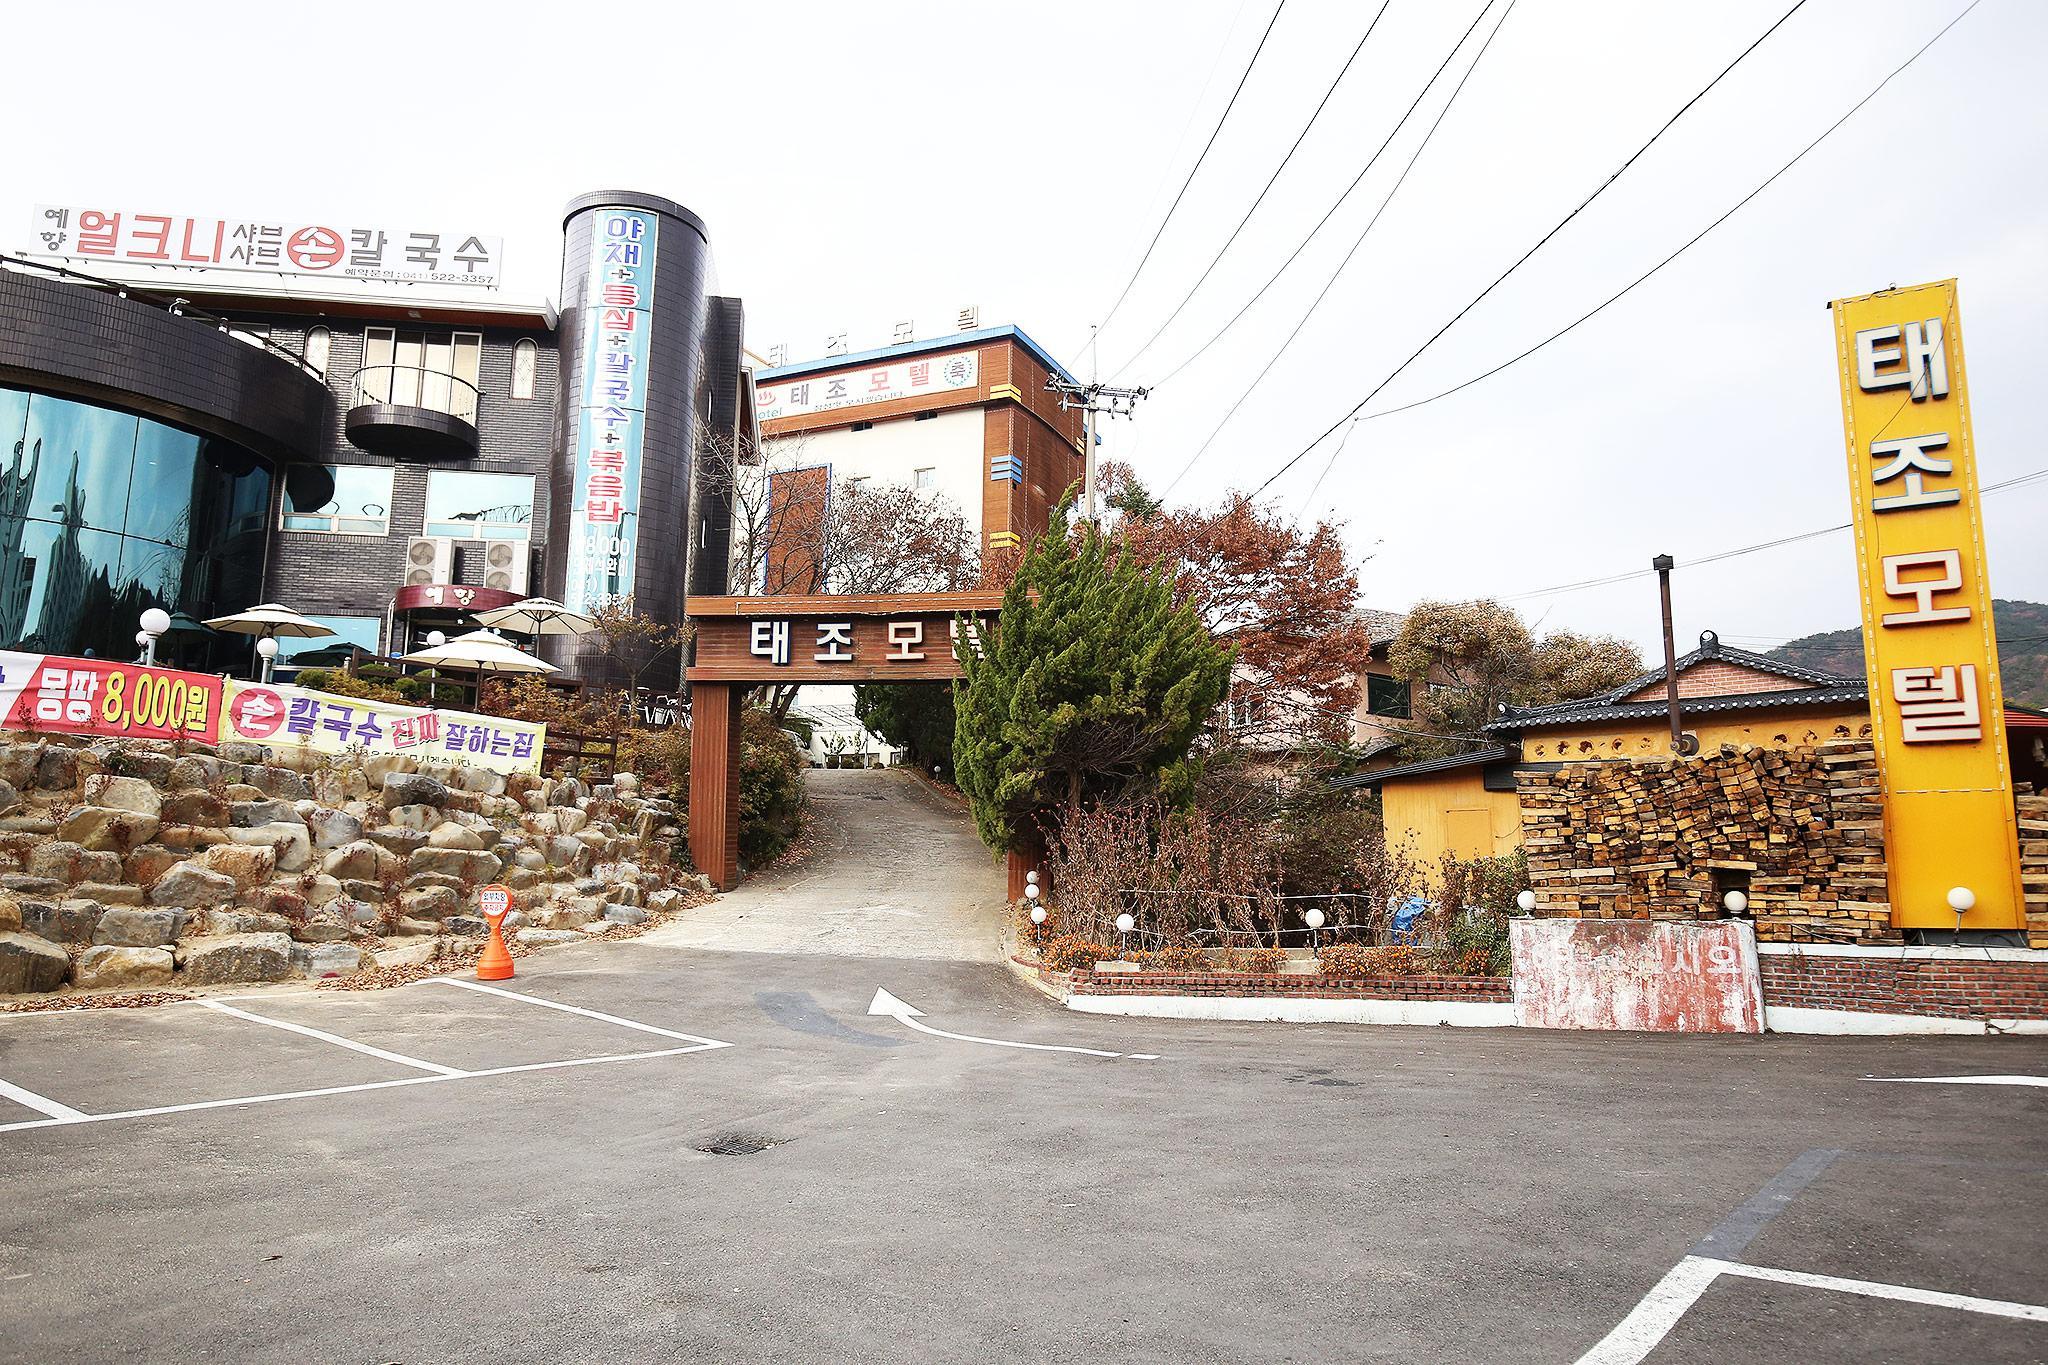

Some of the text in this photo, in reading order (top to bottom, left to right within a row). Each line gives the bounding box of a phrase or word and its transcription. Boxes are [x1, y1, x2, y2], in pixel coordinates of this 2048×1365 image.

[40, 209, 69, 251] 예향
[77, 211, 225, 263] 얼크니
[758, 407, 782, 419] otel
[1855, 318, 1982, 744] 태조모텔
[391, 713, 441, 749] 진짜
